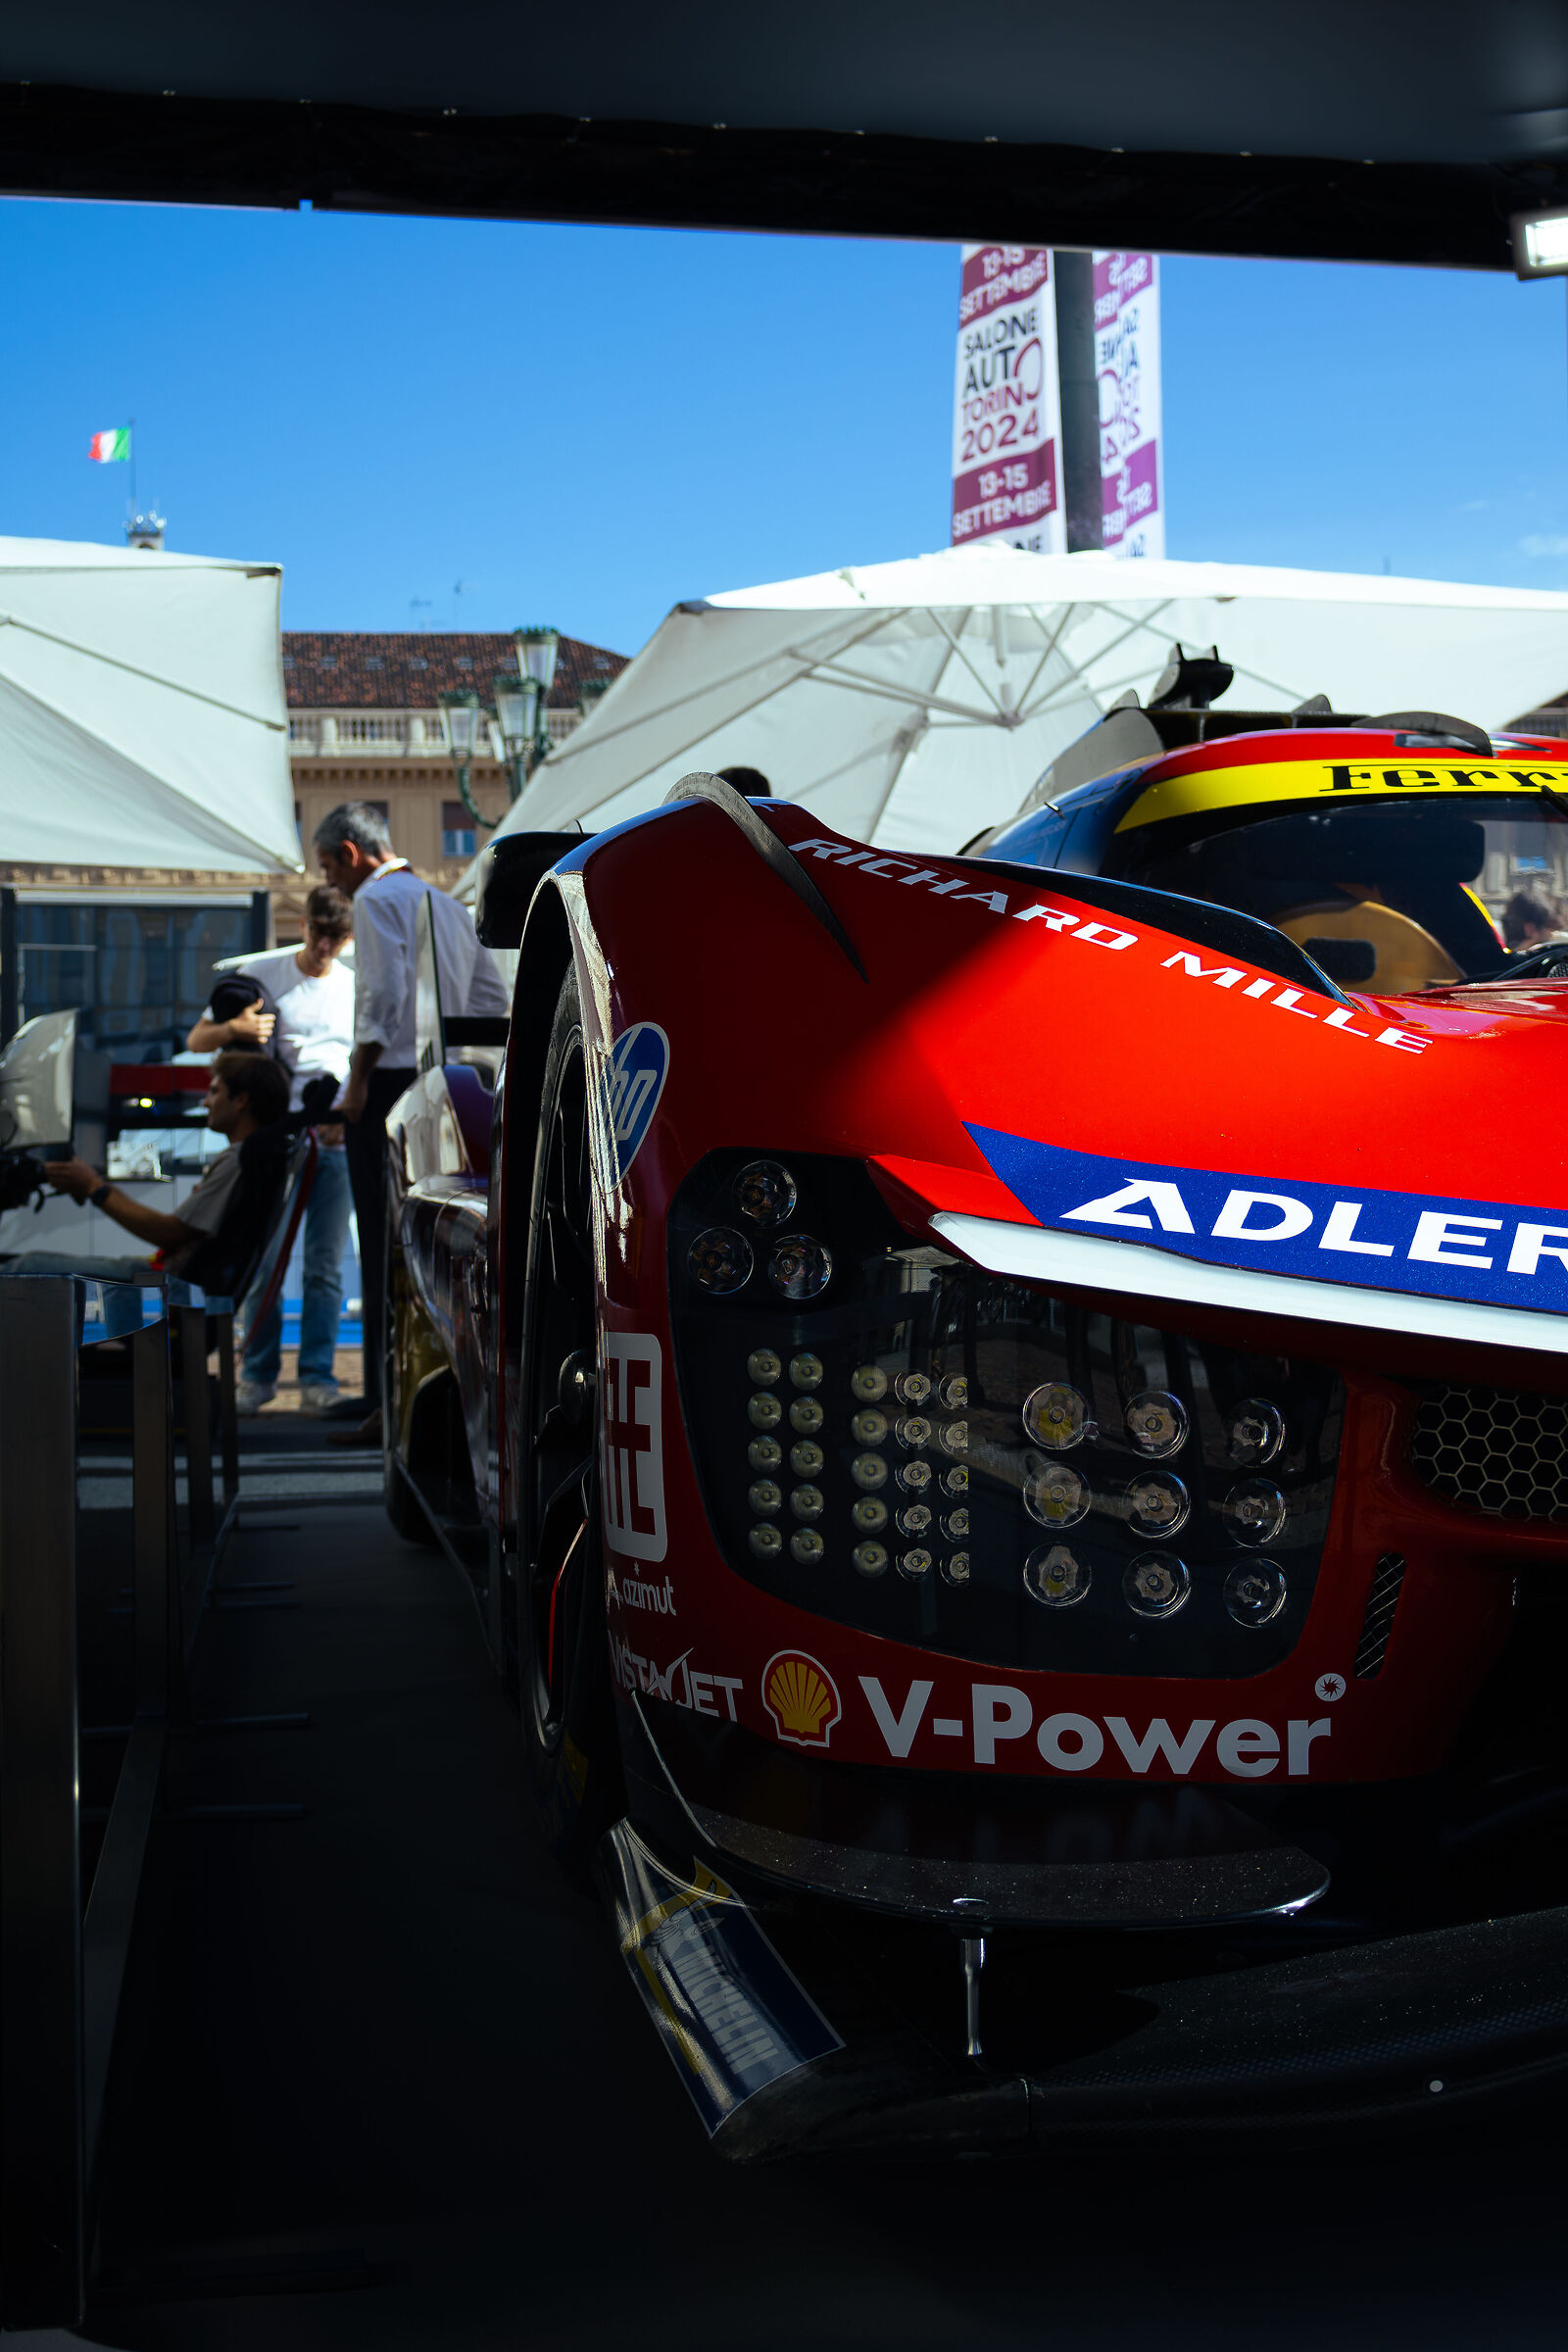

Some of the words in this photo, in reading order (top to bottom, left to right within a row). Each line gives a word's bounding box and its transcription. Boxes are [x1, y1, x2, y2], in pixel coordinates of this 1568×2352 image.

[959, 250, 1047, 321] SETTEMBRE
[964, 307, 1037, 359] SALONE
[961, 408, 1039, 462] 2024
[953, 480, 1052, 537] SETTEMBRE
[979, 463, 1028, 499] 13-15
[1319, 763, 1568, 792] Ferr
[788, 838, 1139, 951] RICHARD
[1160, 951, 1434, 1054] MILLE
[1059, 1178, 1568, 1275] ADLER
[858, 1675, 1332, 1779] V-Power
[671, 1945, 780, 2076] MICHELIN
